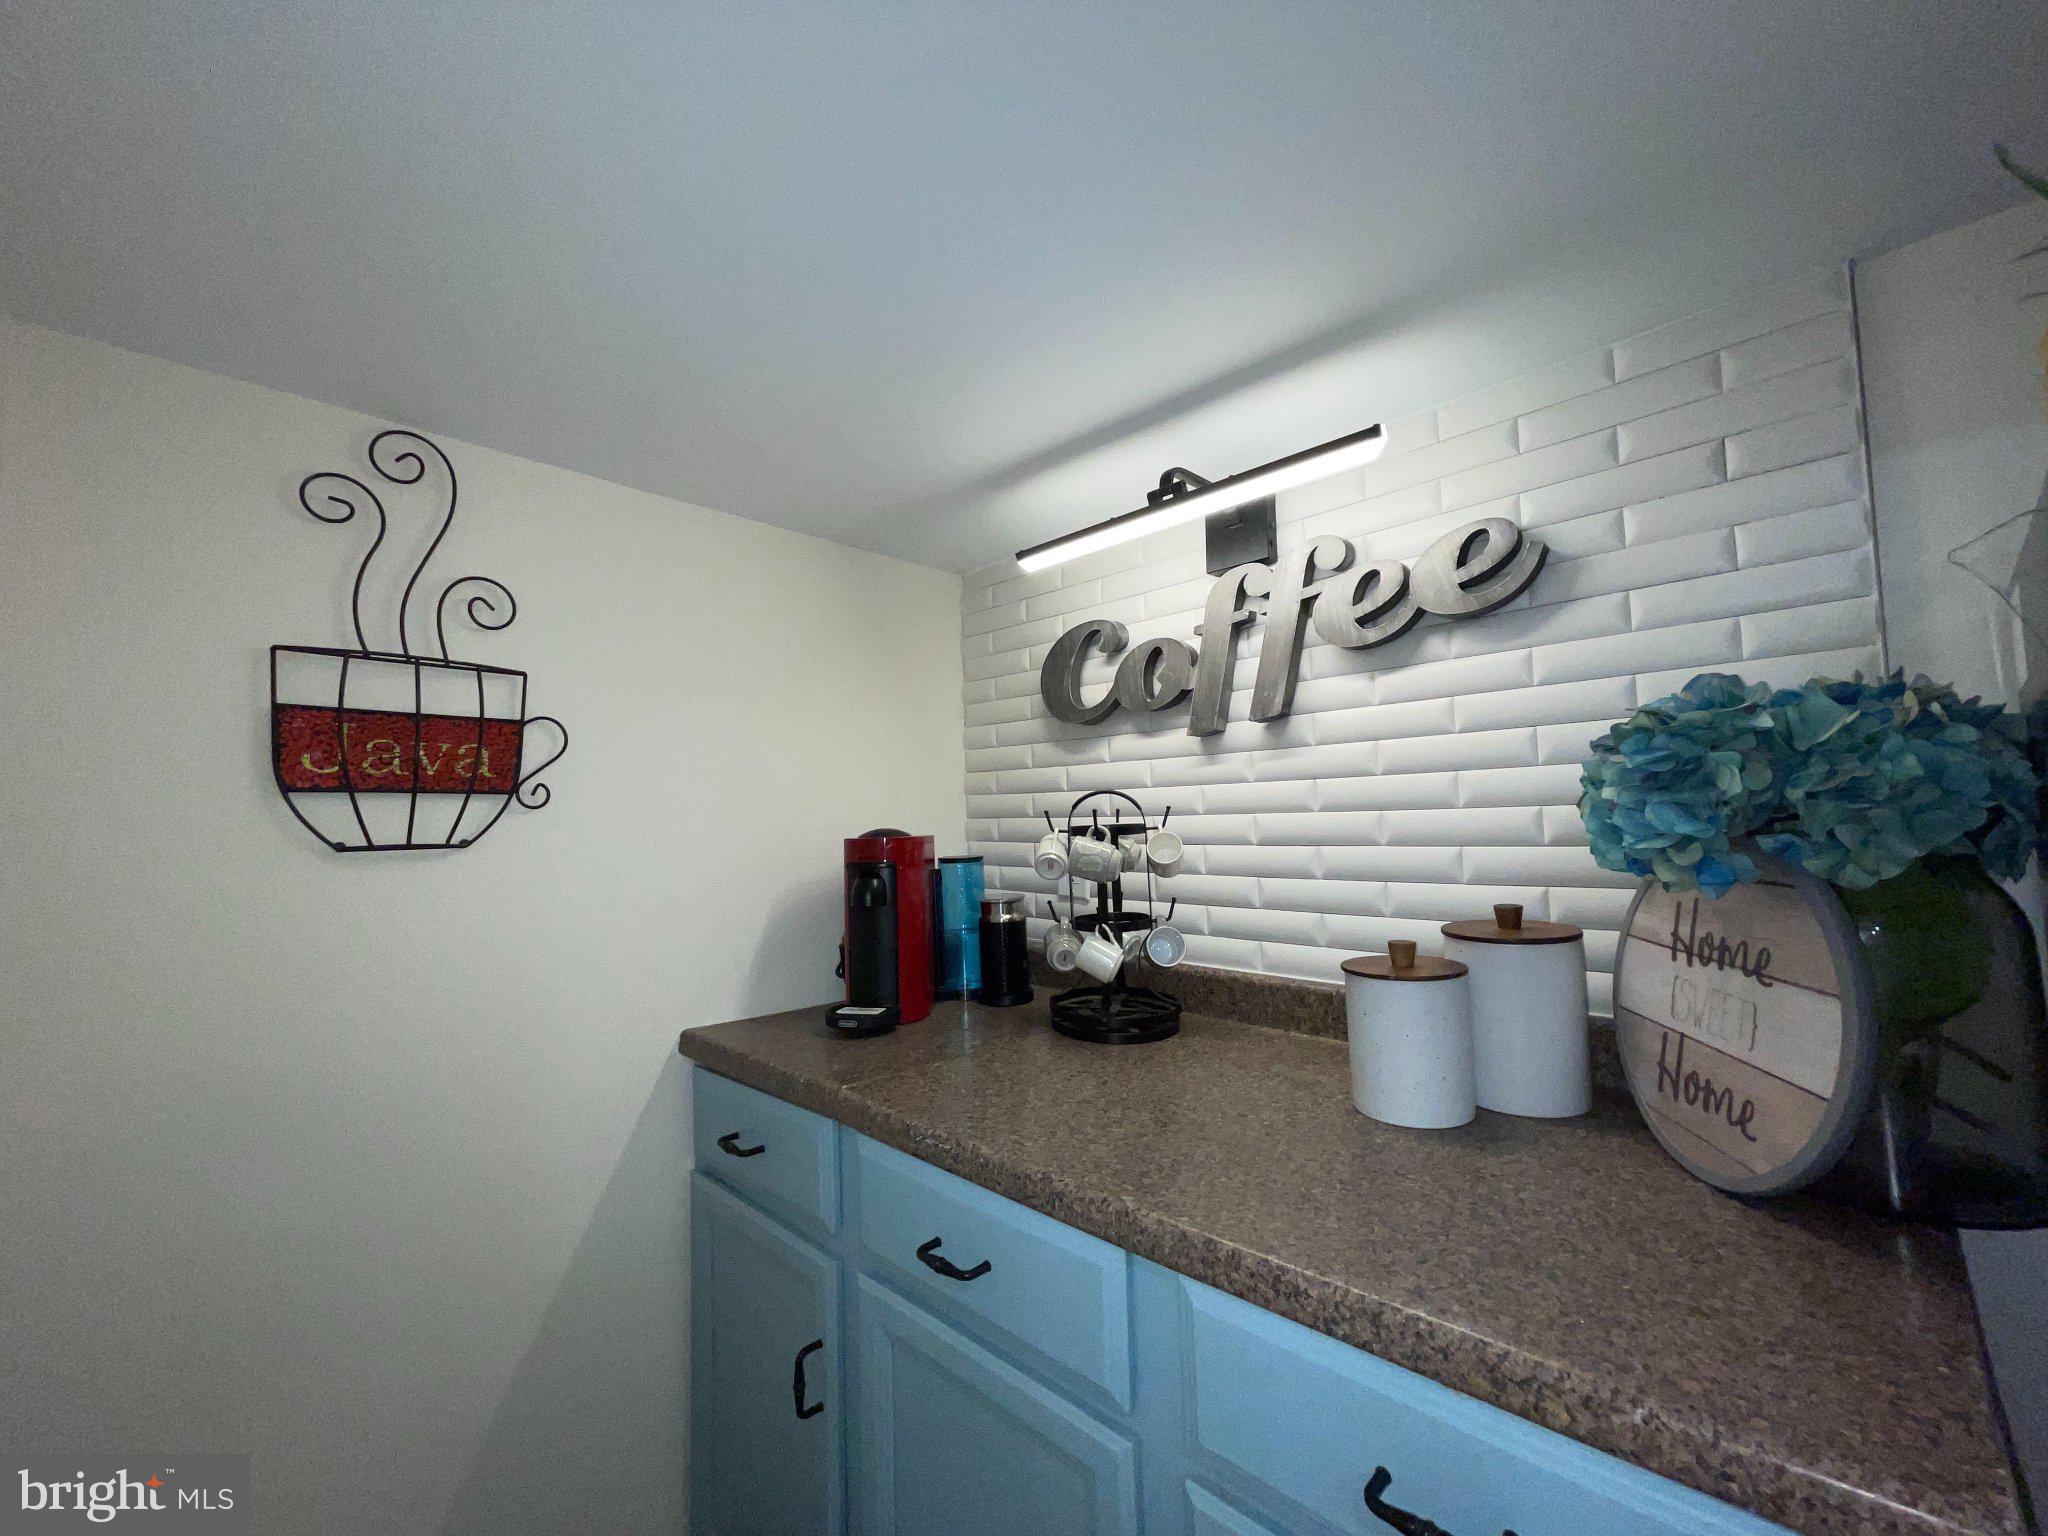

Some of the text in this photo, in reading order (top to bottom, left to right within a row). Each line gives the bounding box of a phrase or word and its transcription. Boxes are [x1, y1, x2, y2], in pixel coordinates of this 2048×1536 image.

[301, 722, 497, 778] Java
[1671, 897, 1774, 988] Home
[1656, 1031, 1758, 1143] Home
